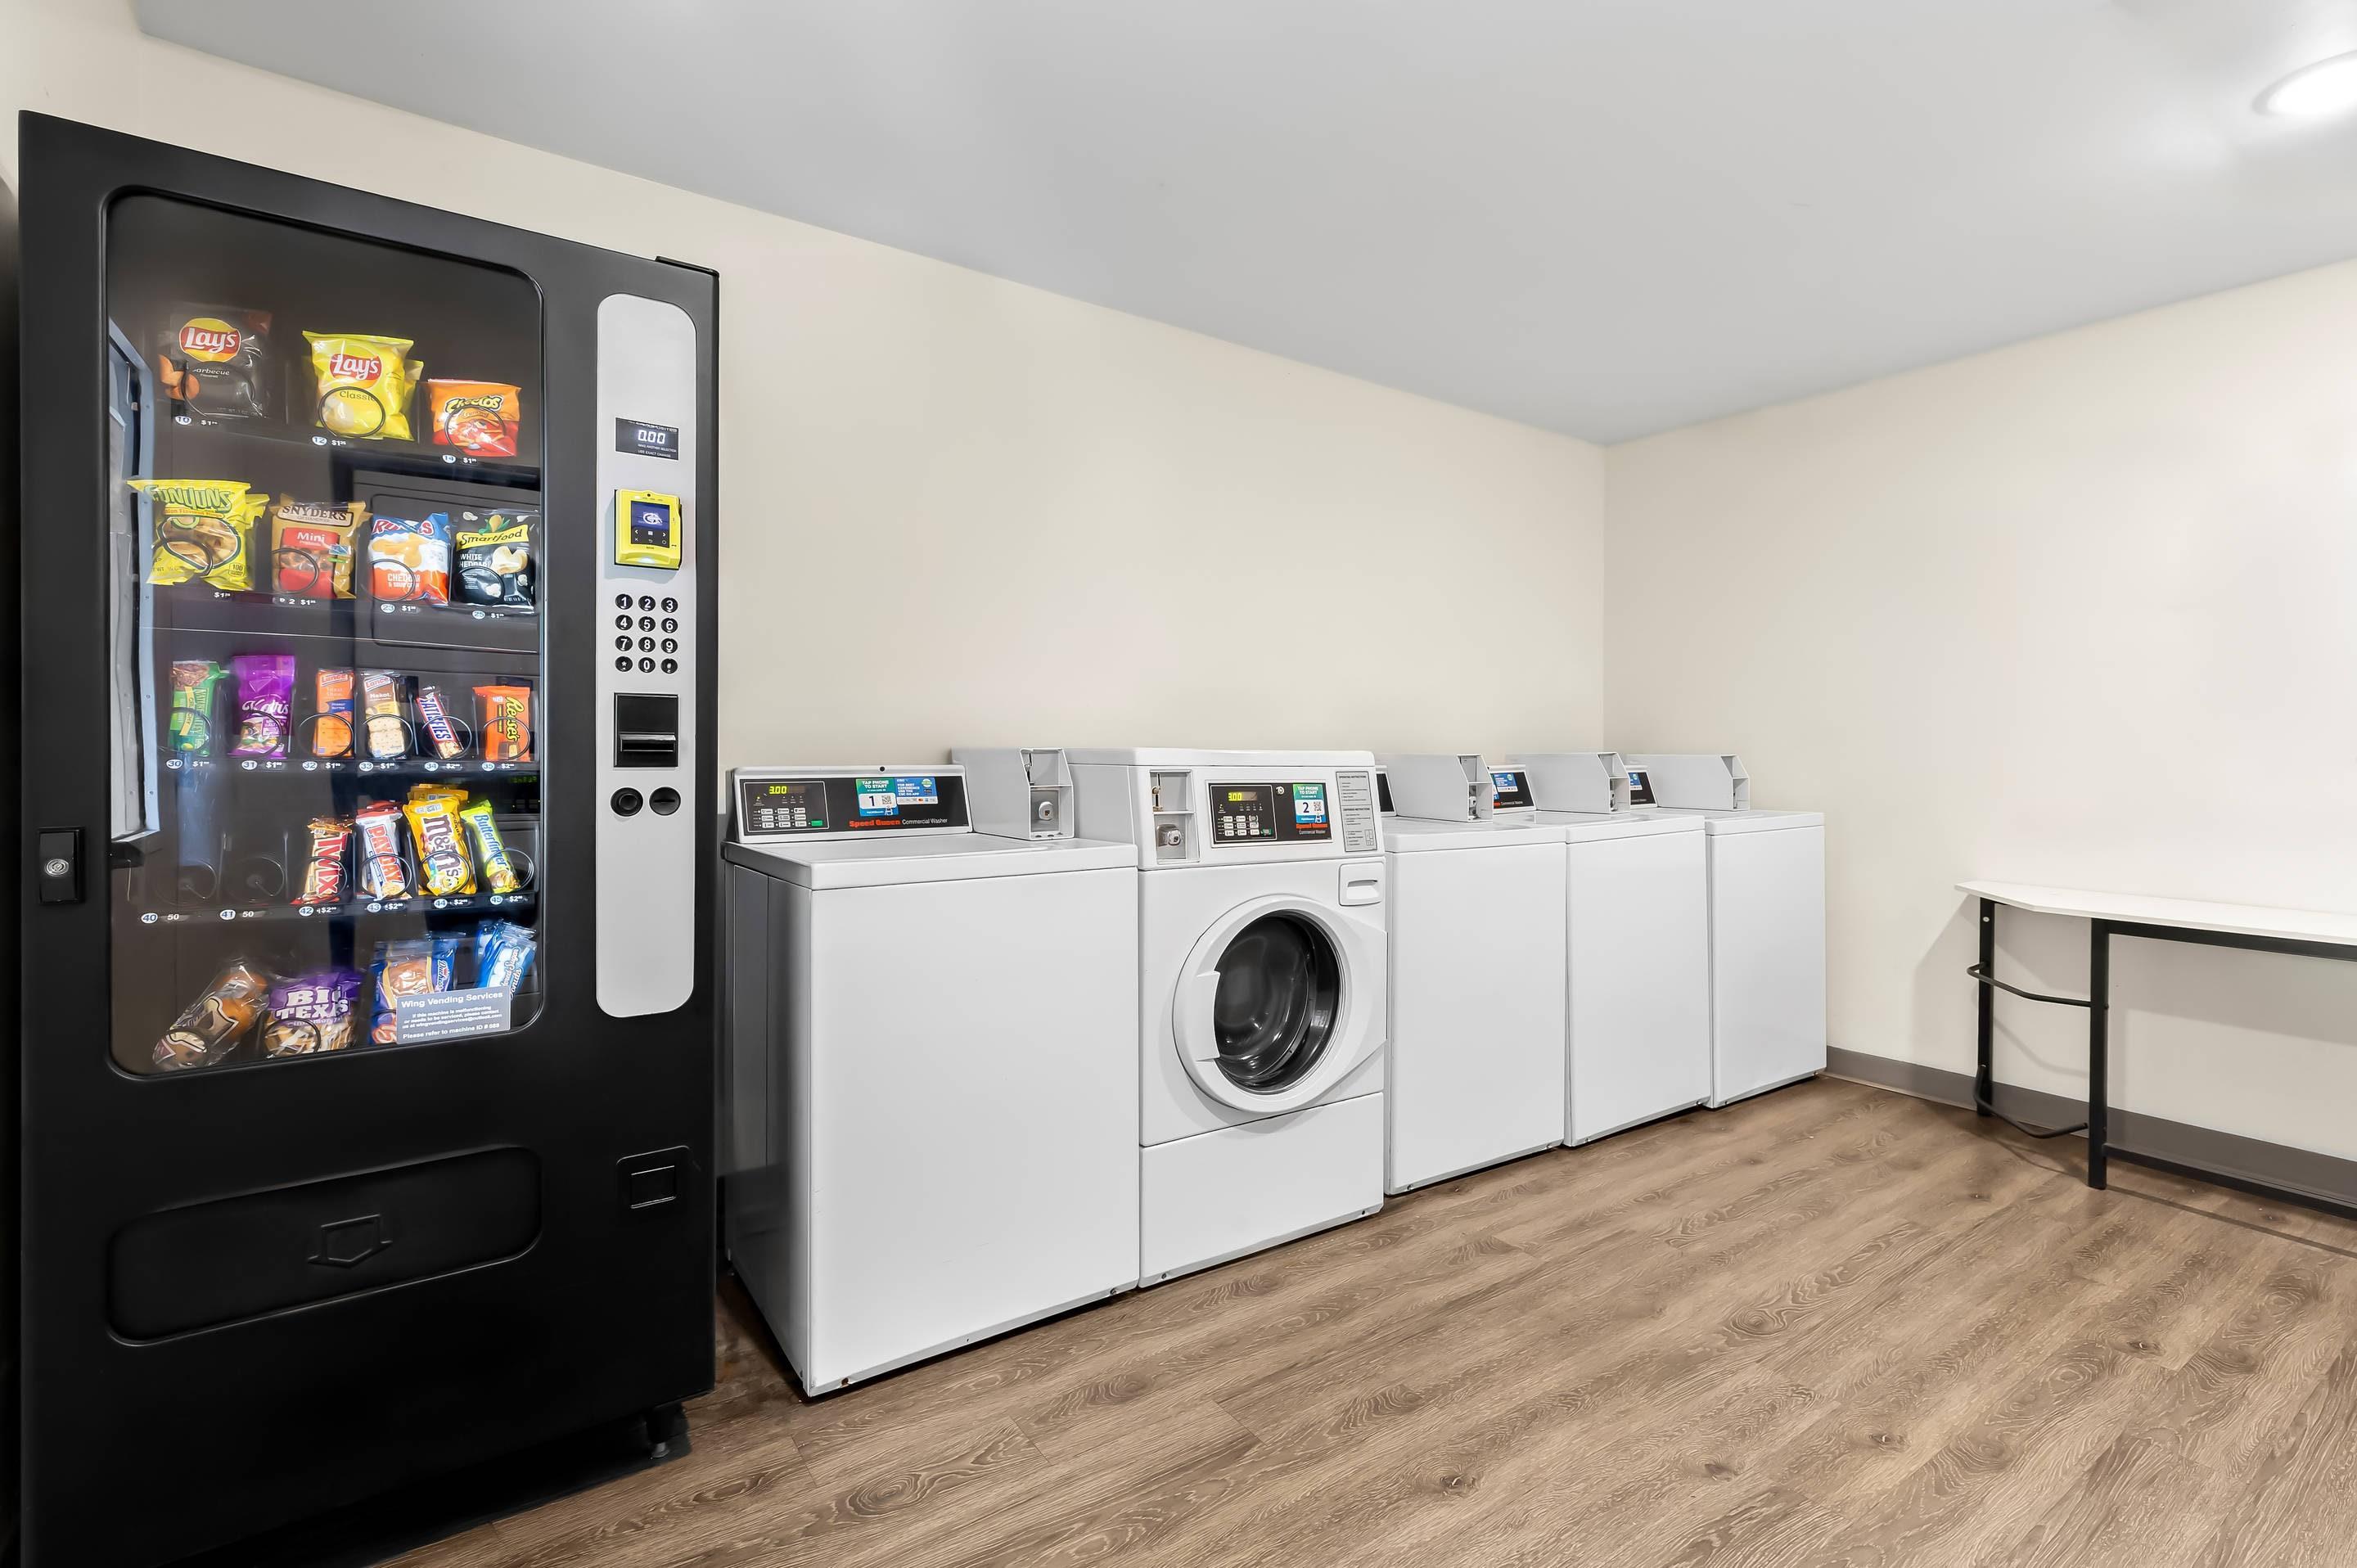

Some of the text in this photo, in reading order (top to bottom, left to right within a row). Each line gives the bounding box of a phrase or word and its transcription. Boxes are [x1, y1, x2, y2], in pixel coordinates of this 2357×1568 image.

[184, 327, 237, 354] Lay's
[333, 354, 380, 380] Lay's
[459, 529, 523, 546] Smartfood
[621, 597, 627, 606] 1
[644, 598, 651, 608] 2
[666, 600, 674, 611] 3
[620, 617, 628, 628] 4
[643, 620, 651, 629] 5
[666, 620, 674, 630] 6
[620, 638, 628, 649] 7
[644, 639, 651, 650] 8
[666, 641, 674, 651] 9
[643, 660, 651, 670] 0
[505, 696, 525, 742] Reese's
[868, 795, 875, 807] 1
[1302, 802, 1309, 813] 2
[473, 814, 507, 867] Butterfinger
[314, 831, 348, 896] TWIX
[142, 914, 157, 922] 40
[401, 992, 503, 1008] Wing Vending Services
